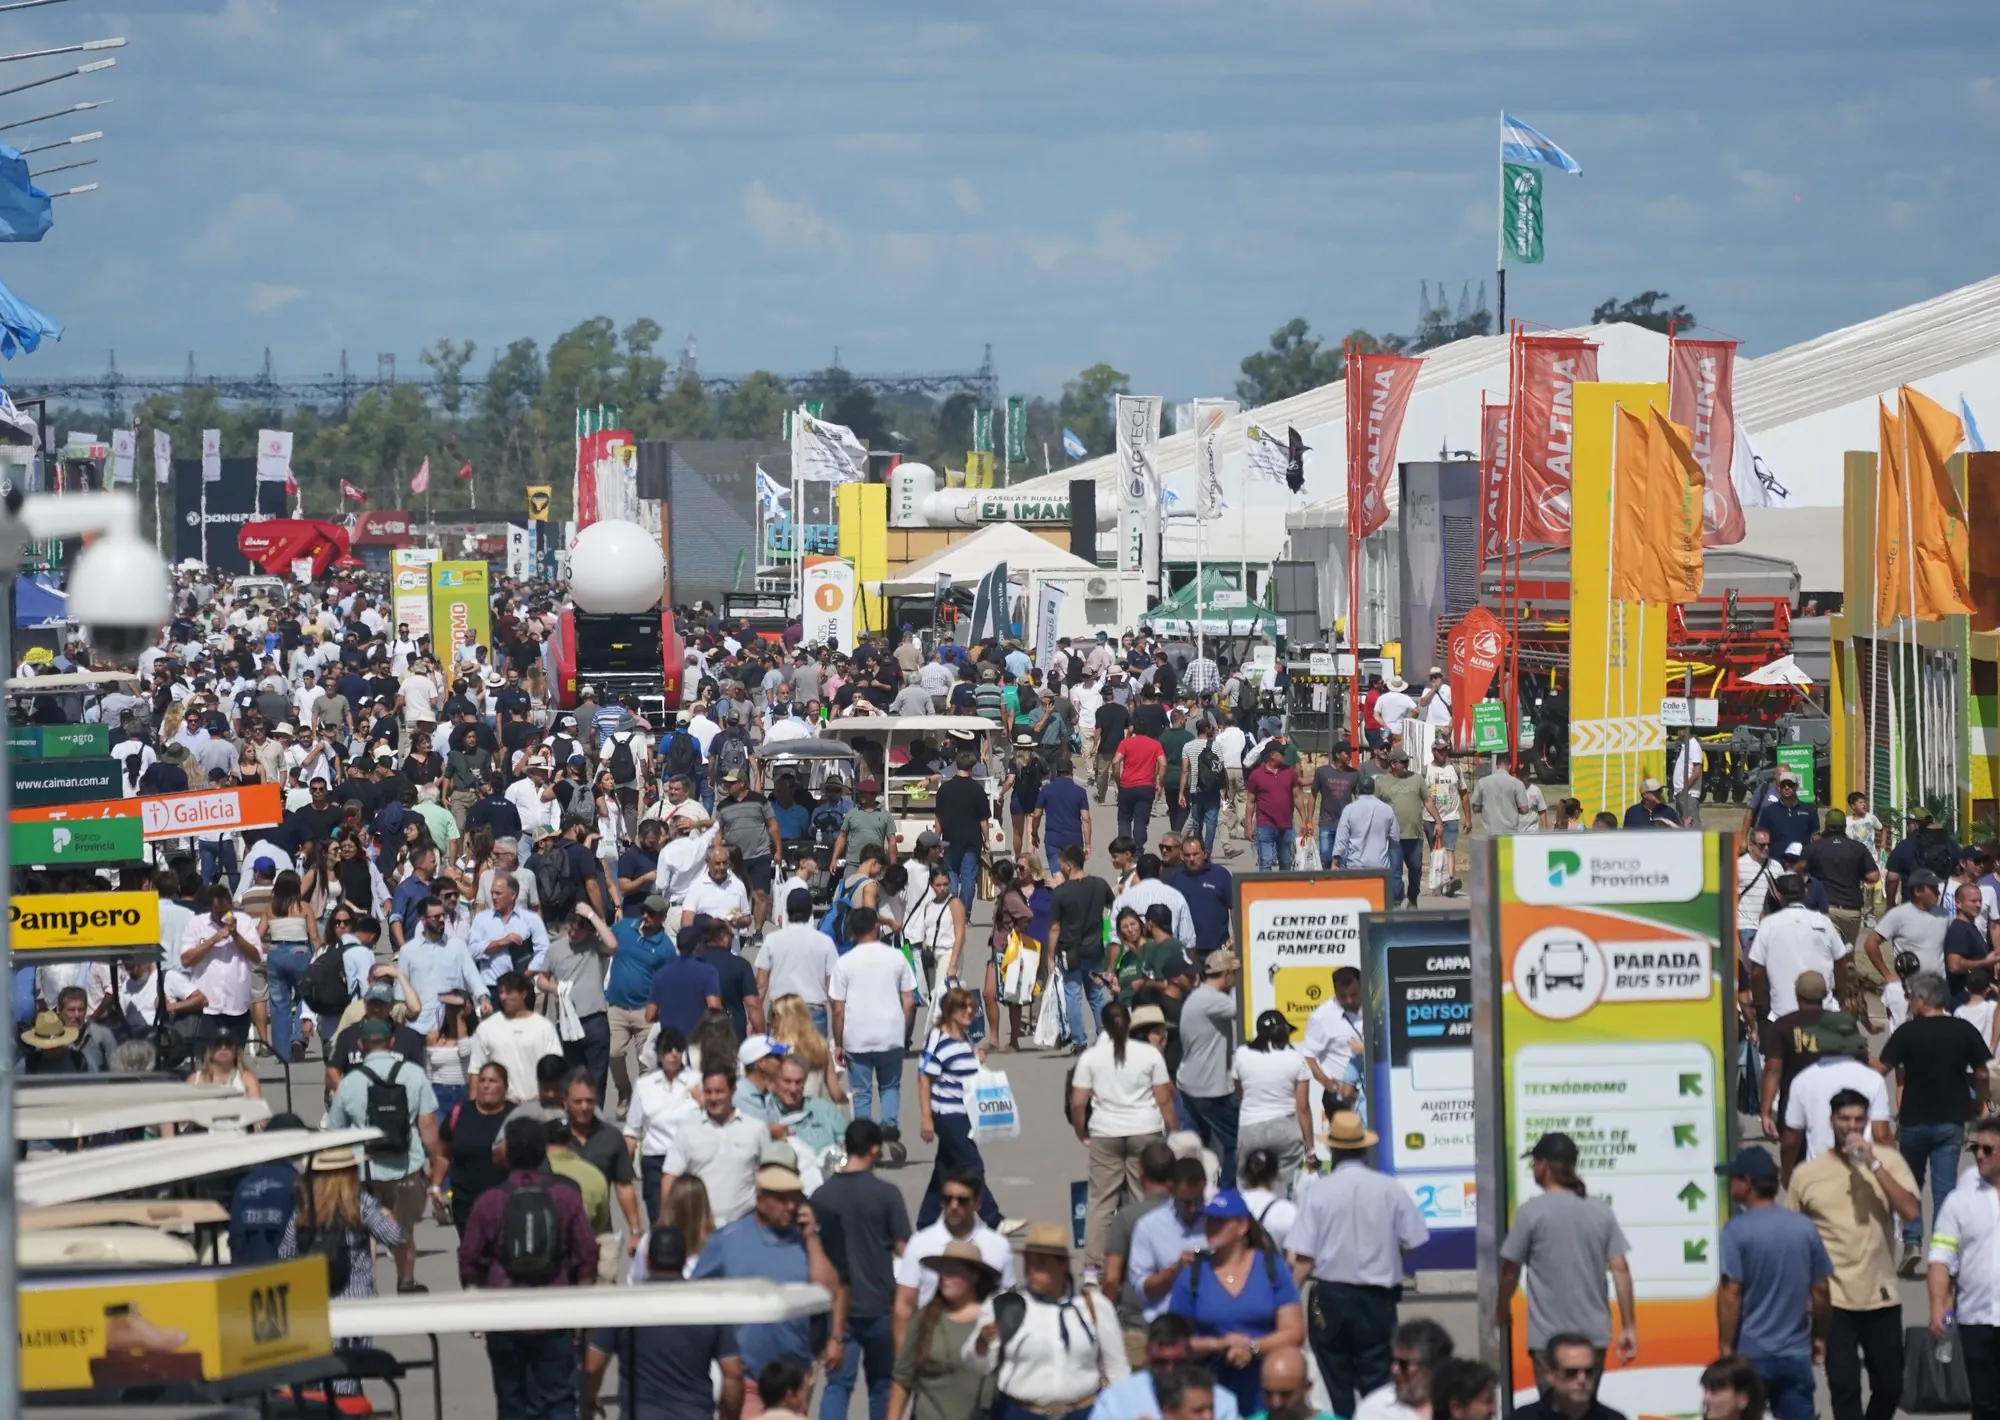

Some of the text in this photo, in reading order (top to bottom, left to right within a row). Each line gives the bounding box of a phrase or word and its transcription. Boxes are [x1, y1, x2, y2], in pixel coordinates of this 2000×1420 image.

[1367, 369, 1395, 478] ALTINA
[1546, 357, 1576, 480] ALTINA
[1691, 356, 1717, 482] ALTINA
[1131, 399, 1145, 478] AGTECH
[982, 502, 1072, 520] EL IMAN
[1681, 536, 1692, 552] de
[824, 588, 834, 607] 1
[1608, 599, 1628, 668] Banc
[1662, 701, 1687, 710] Calle 9
[72, 732, 95, 746] agro
[15, 776, 110, 790] www.caiman.com.ar
[174, 797, 234, 824] Galicia
[74, 832, 100, 841] Banco
[74, 842, 115, 852] Provincia
[1590, 857, 1641, 872] Banco
[1590, 872, 1670, 888] Provincia
[1272, 914, 1349, 927] CENTRO DE
[1277, 943, 1346, 956] PAMPERO
[1425, 955, 1471, 972] CARPA
[1614, 952, 1700, 970] PARADA
[1616, 973, 1700, 989] BUS STOP
[1405, 986, 1456, 1001] ESPACIO
[1524, 1077, 1628, 1095] TECNÓDROMO
[979, 1100, 1012, 1112] OMBU
[1525, 1116, 1594, 1129] SHOW DE
[1610, 1130, 1629, 1142] DE
[250, 1283, 290, 1346] CAT
